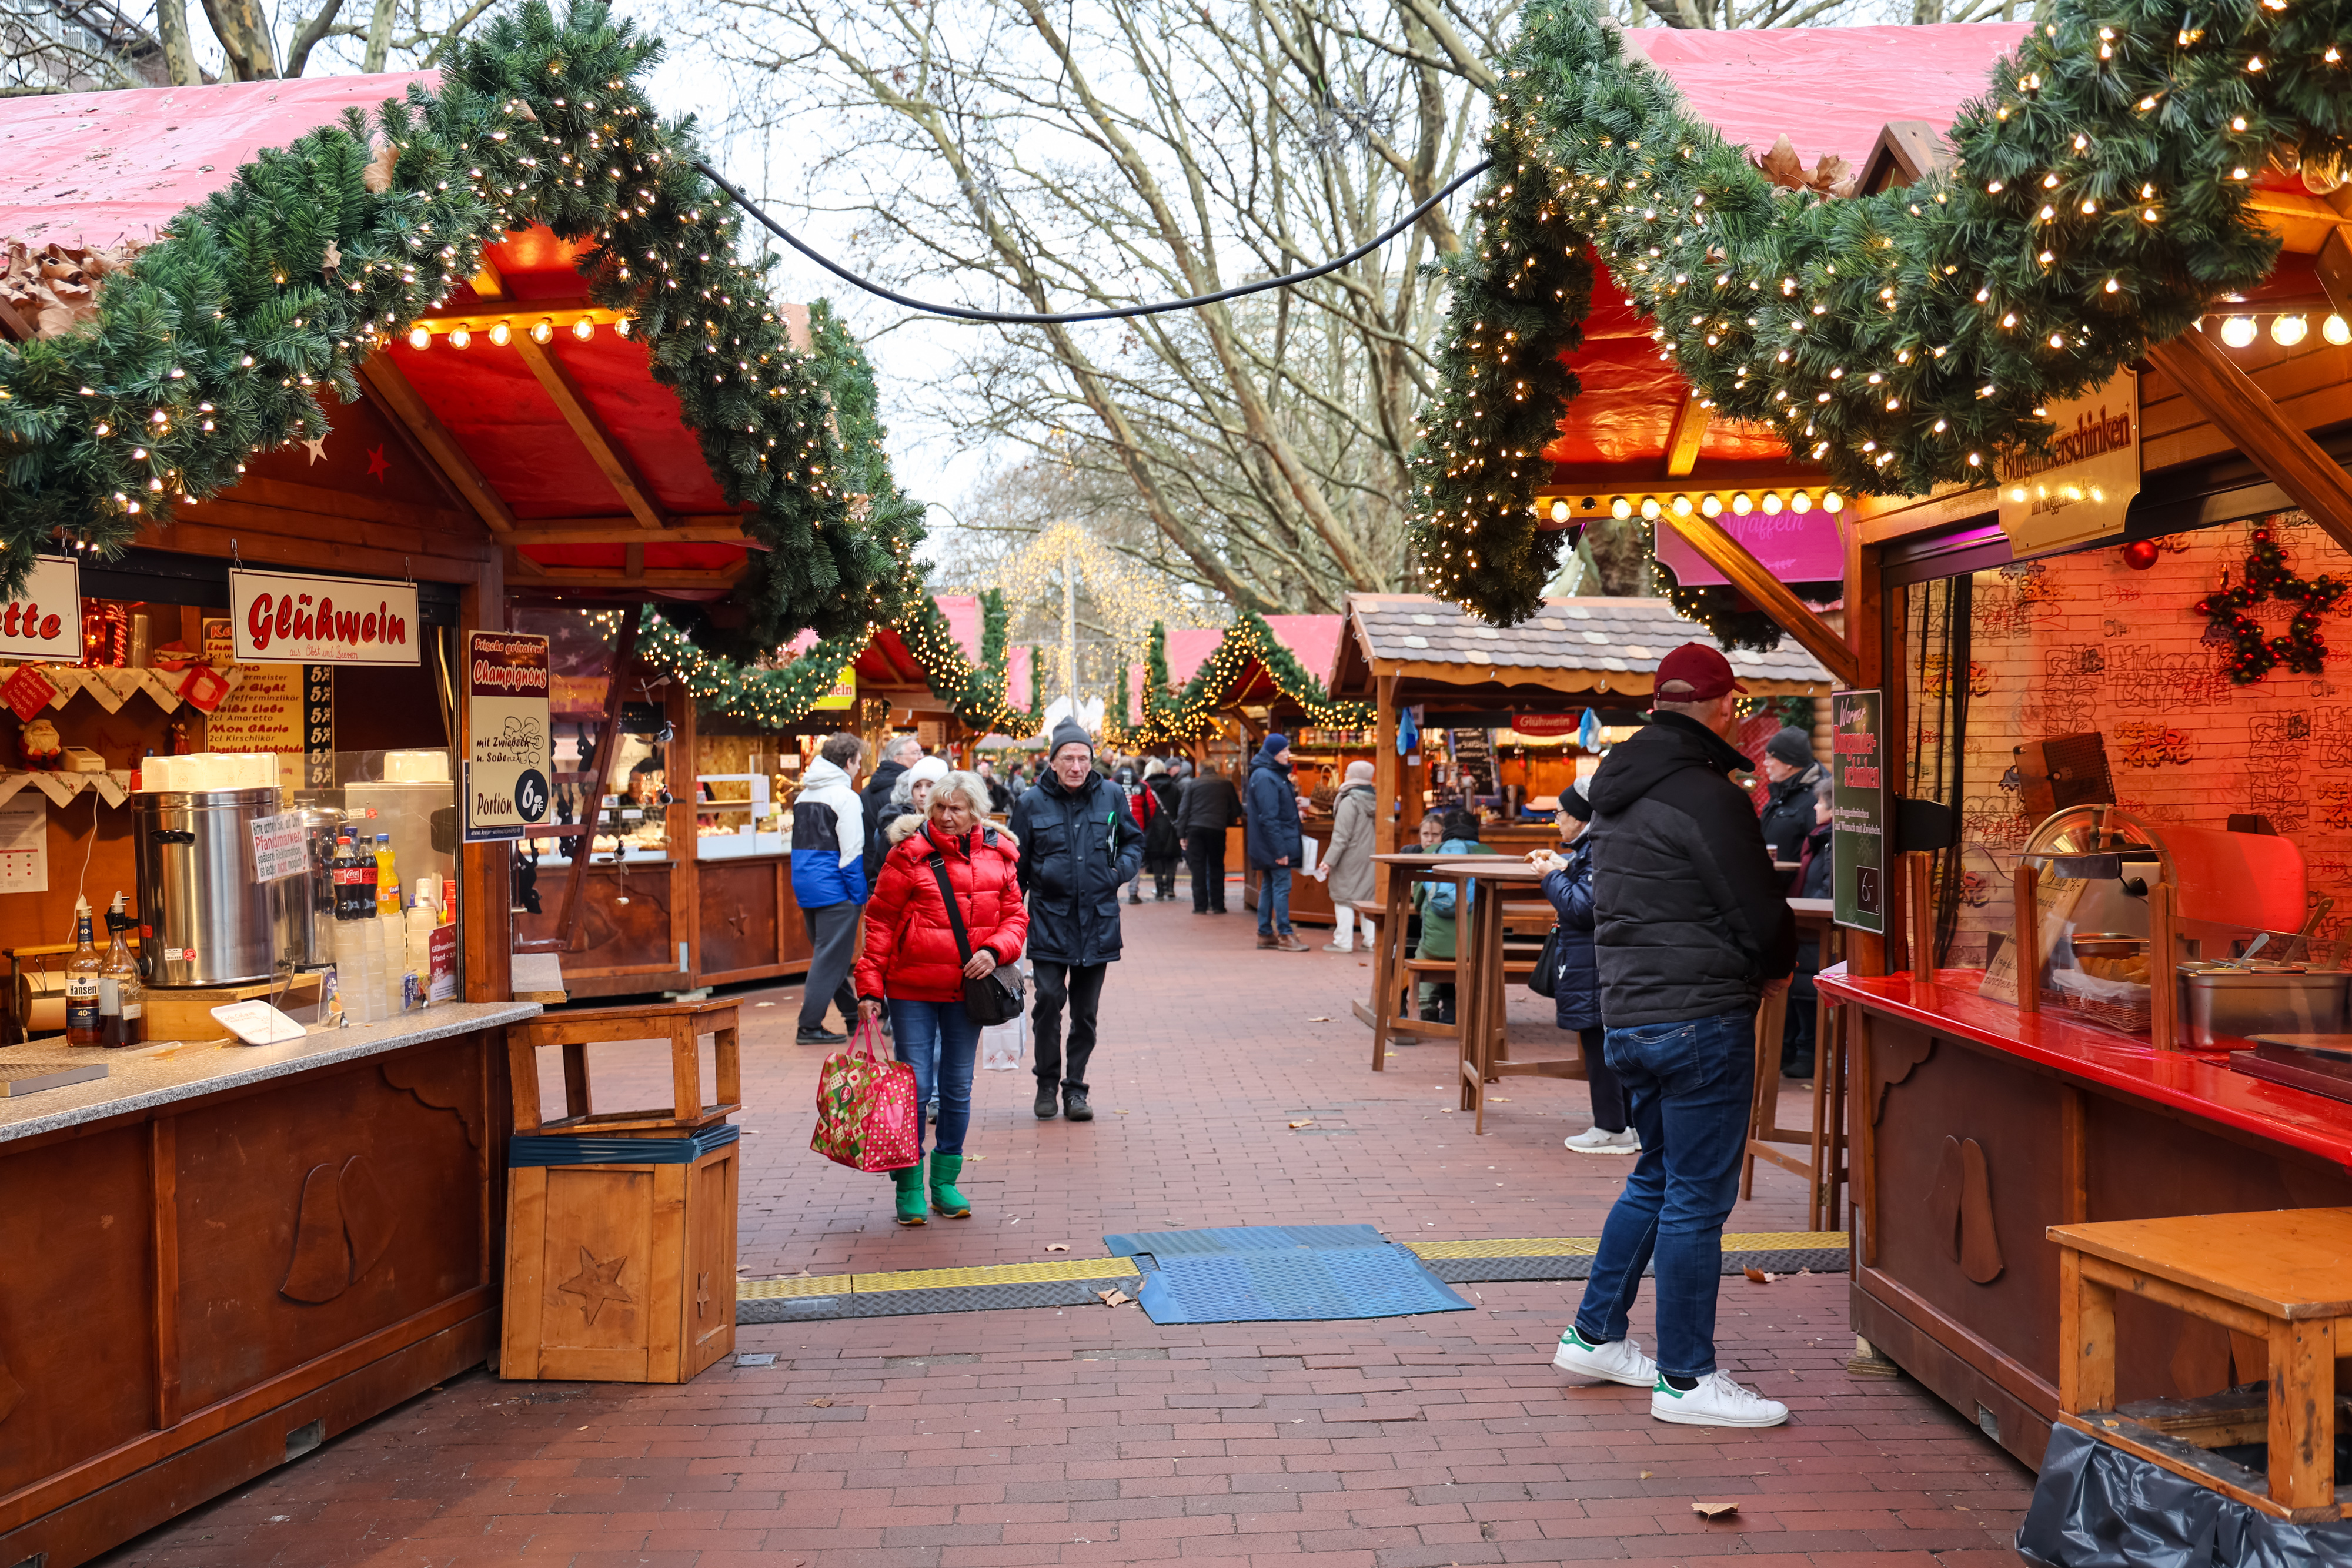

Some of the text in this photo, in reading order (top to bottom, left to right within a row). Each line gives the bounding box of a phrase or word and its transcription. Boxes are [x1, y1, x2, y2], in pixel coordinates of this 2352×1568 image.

[1720, 510, 1805, 541] Waffeln
[0, 602, 61, 640] tte
[248, 593, 406, 650] Glühwein
[211, 624, 233, 638] Ka
[207, 642, 233, 651] Lum
[289, 644, 358, 659] aus Obst und Beeren
[475, 638, 544, 655] Frische gebratene
[473, 660, 547, 692] Champignons
[252, 704, 285, 713] Liebe
[1840, 698, 1867, 728] Warmer
[209, 724, 289, 733] Mon Cherie
[1520, 716, 1569, 727] Glühwein
[477, 737, 529, 748] mit Zwiebeln
[1833, 723, 1877, 761] Burgunder-
[254, 744, 303, 755] Schokolade
[487, 752, 507, 763] Soße
[1844, 757, 1880, 788] schinken
[477, 792, 512, 815] Portion
[1835, 805, 1870, 819] im Roggenbrötchen
[252, 821, 263, 836] Bitte
[263, 818, 278, 834] achten
[1840, 821, 1856, 832] Wunsch
[255, 830, 302, 852] Pfandmarken
[258, 851, 275, 866] spätere
[432, 941, 456, 953] Glühweintas
[433, 954, 446, 963] Pfand
[70, 985, 97, 995] Hansen
